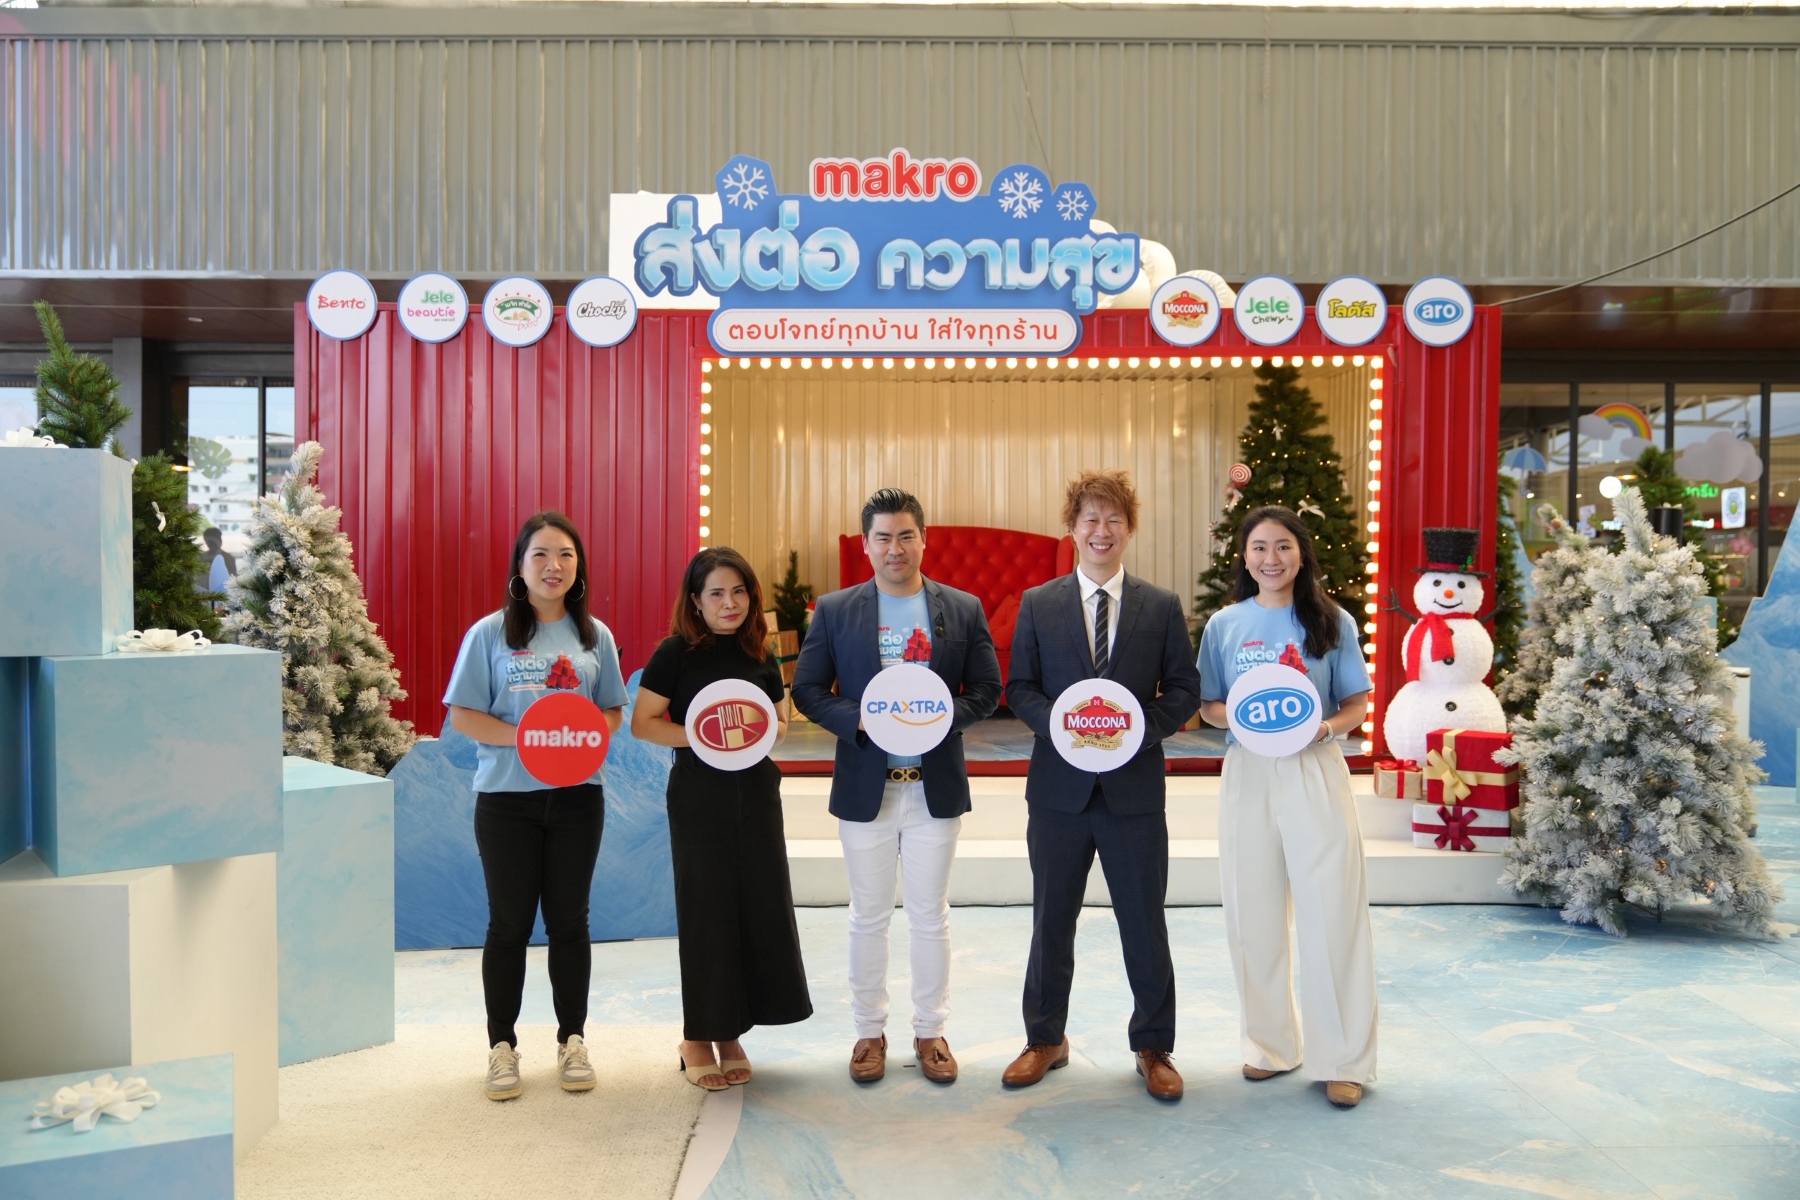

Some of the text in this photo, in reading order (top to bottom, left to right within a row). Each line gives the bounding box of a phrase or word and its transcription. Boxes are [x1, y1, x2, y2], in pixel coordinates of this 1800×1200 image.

[814, 151, 978, 198] makro
[640, 199, 1136, 309] ส่งต่อ ความสุข
[317, 294, 366, 310] Bento
[420, 289, 454, 304] Jele
[1244, 296, 1290, 314] Jele
[576, 300, 627, 320] Chocky
[1421, 303, 1456, 319] aro
[728, 317, 1058, 347] ตอบโจทย์ทุกบ้าน ใส่ใจทุกร้าน
[866, 700, 948, 714] CP AXTRA
[1248, 696, 1302, 724] aro
[524, 725, 603, 748] makro
